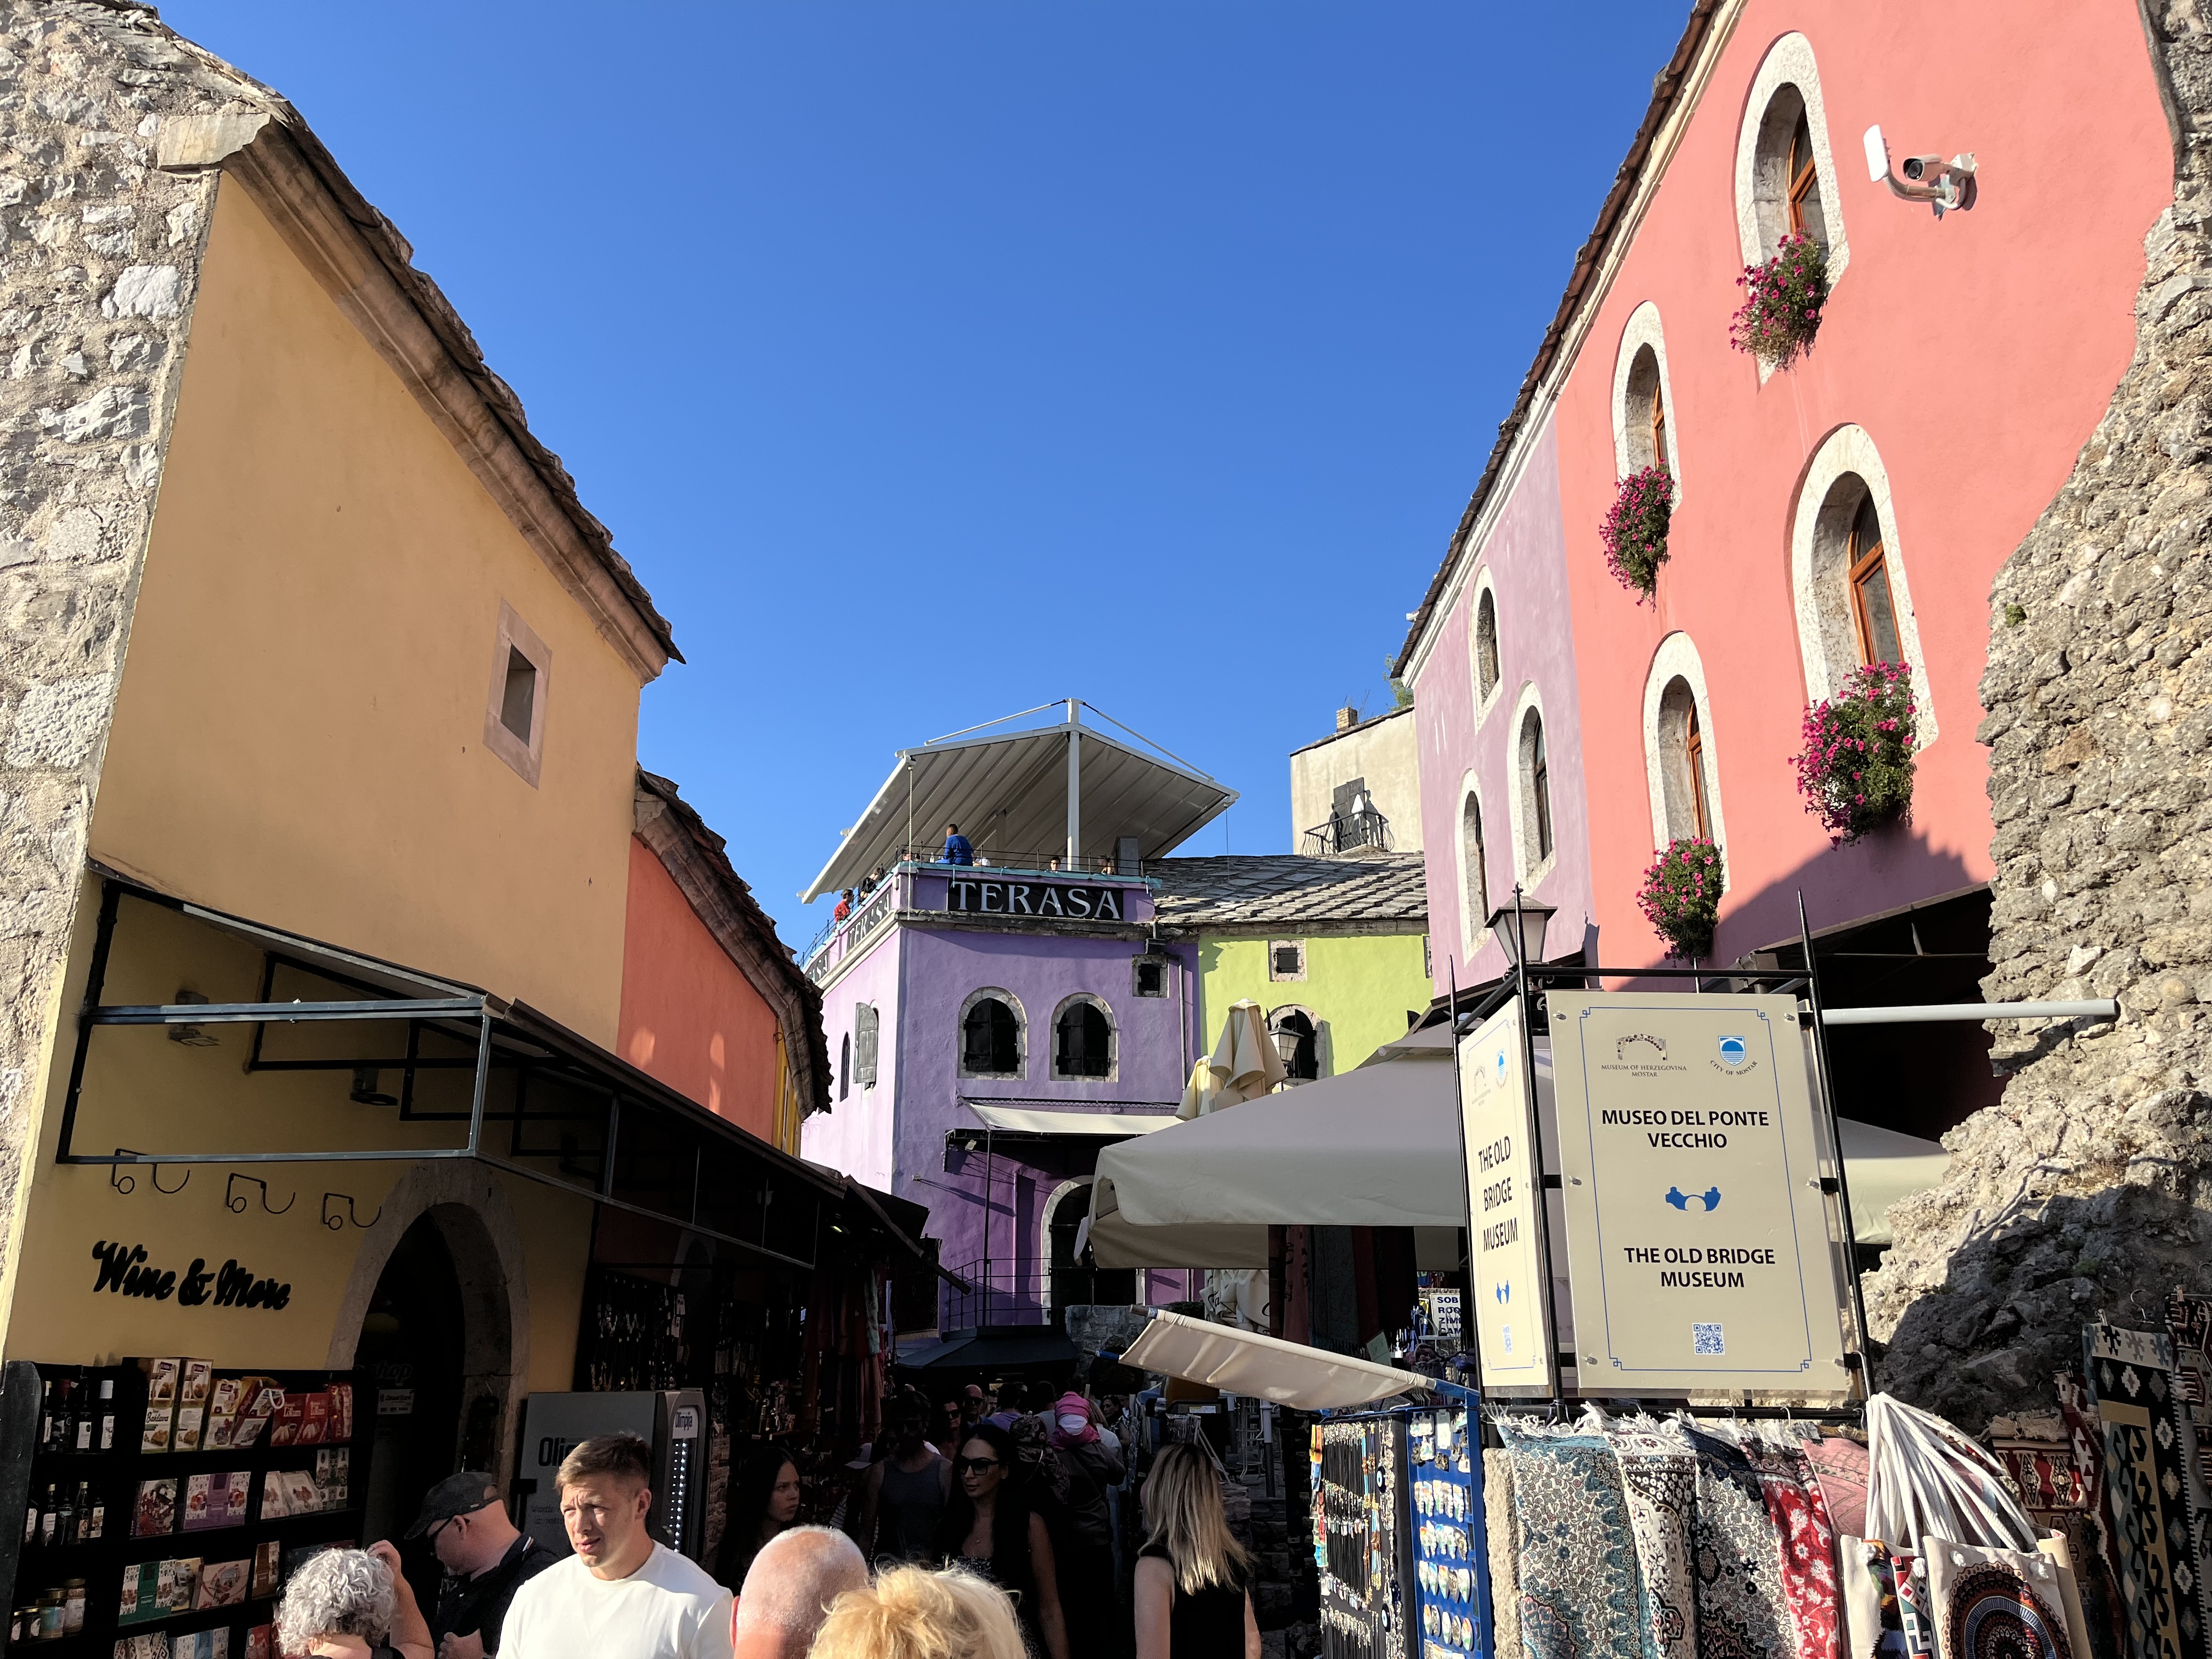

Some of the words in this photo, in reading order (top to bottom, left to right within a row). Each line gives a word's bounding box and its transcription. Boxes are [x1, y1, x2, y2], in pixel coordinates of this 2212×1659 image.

[950, 881, 1122, 919] TERASA
[1710, 1060, 1723, 1072] CITY
[1736, 1060, 1758, 1075] MOSTAR
[1602, 1110, 1667, 1125] MUSEO
[1671, 1111, 1706, 1125] DEL
[1709, 1111, 1769, 1126] PONTE
[1478, 1145, 1493, 1173] THE
[1494, 1136, 1511, 1165] OLD
[1647, 1133, 1728, 1148] VECCHIO
[1483, 1177, 1513, 1211] BRIDGE
[1483, 1217, 1518, 1252] MUSEUM
[1624, 1248, 1661, 1263] THE
[1664, 1248, 1702, 1263] OLD
[1707, 1249, 1775, 1264] BRIDGE
[92, 1240, 176, 1300] Wine
[178, 1258, 216, 1306] &
[213, 1259, 291, 1311] More
[1661, 1271, 1745, 1288] MUSEUM
[538, 1437, 578, 1466] Oli
